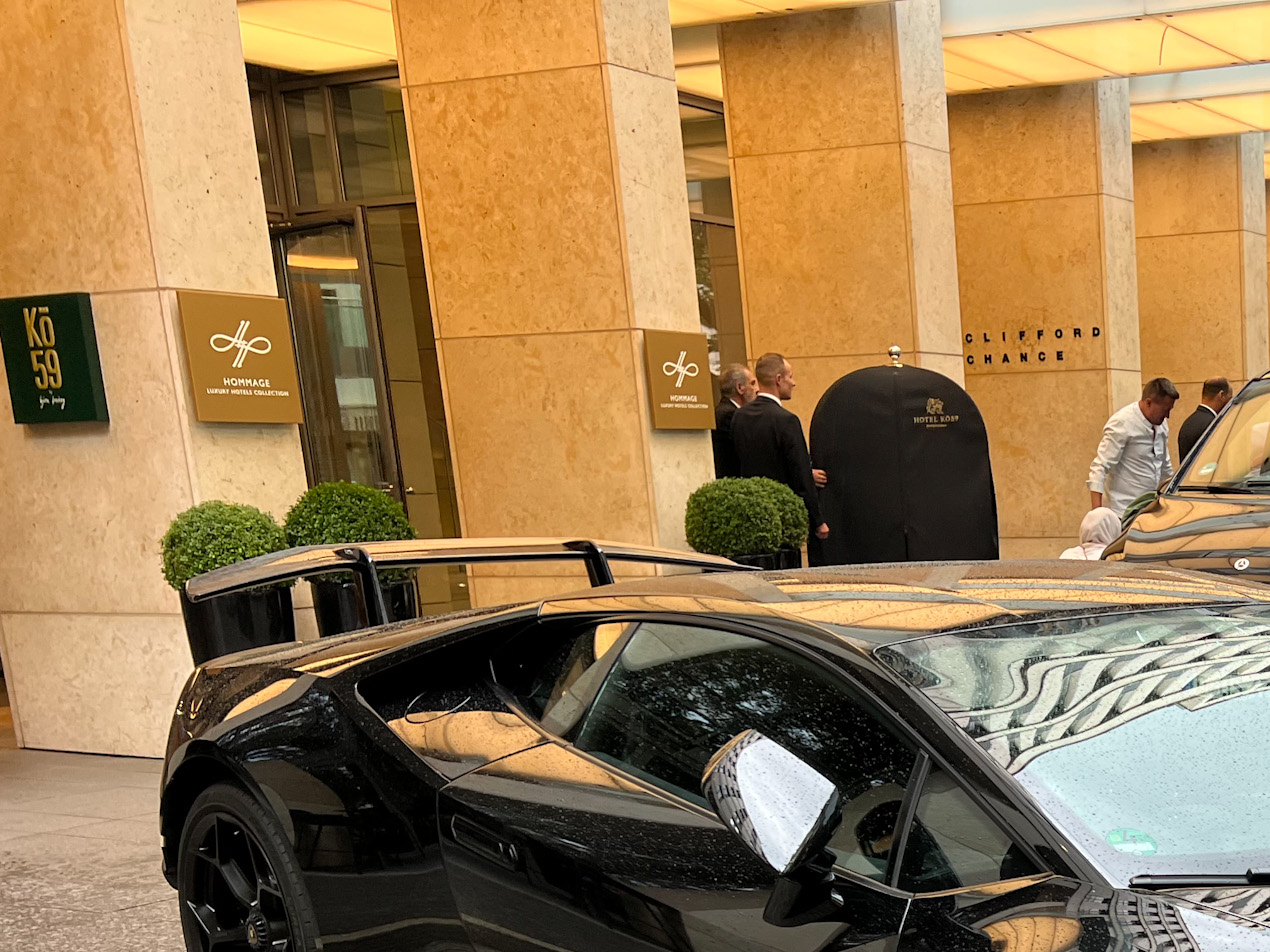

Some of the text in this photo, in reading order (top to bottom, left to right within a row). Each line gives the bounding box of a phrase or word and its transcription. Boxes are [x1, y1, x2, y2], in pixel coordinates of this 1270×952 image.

[965, 327, 1101, 343] CLIFFORD
[966, 351, 1064, 365] CHANCE
[30, 349, 62, 390] 59
[223, 377, 270, 388] HOMMAGE
[913, 416, 939, 424] HOTEL
